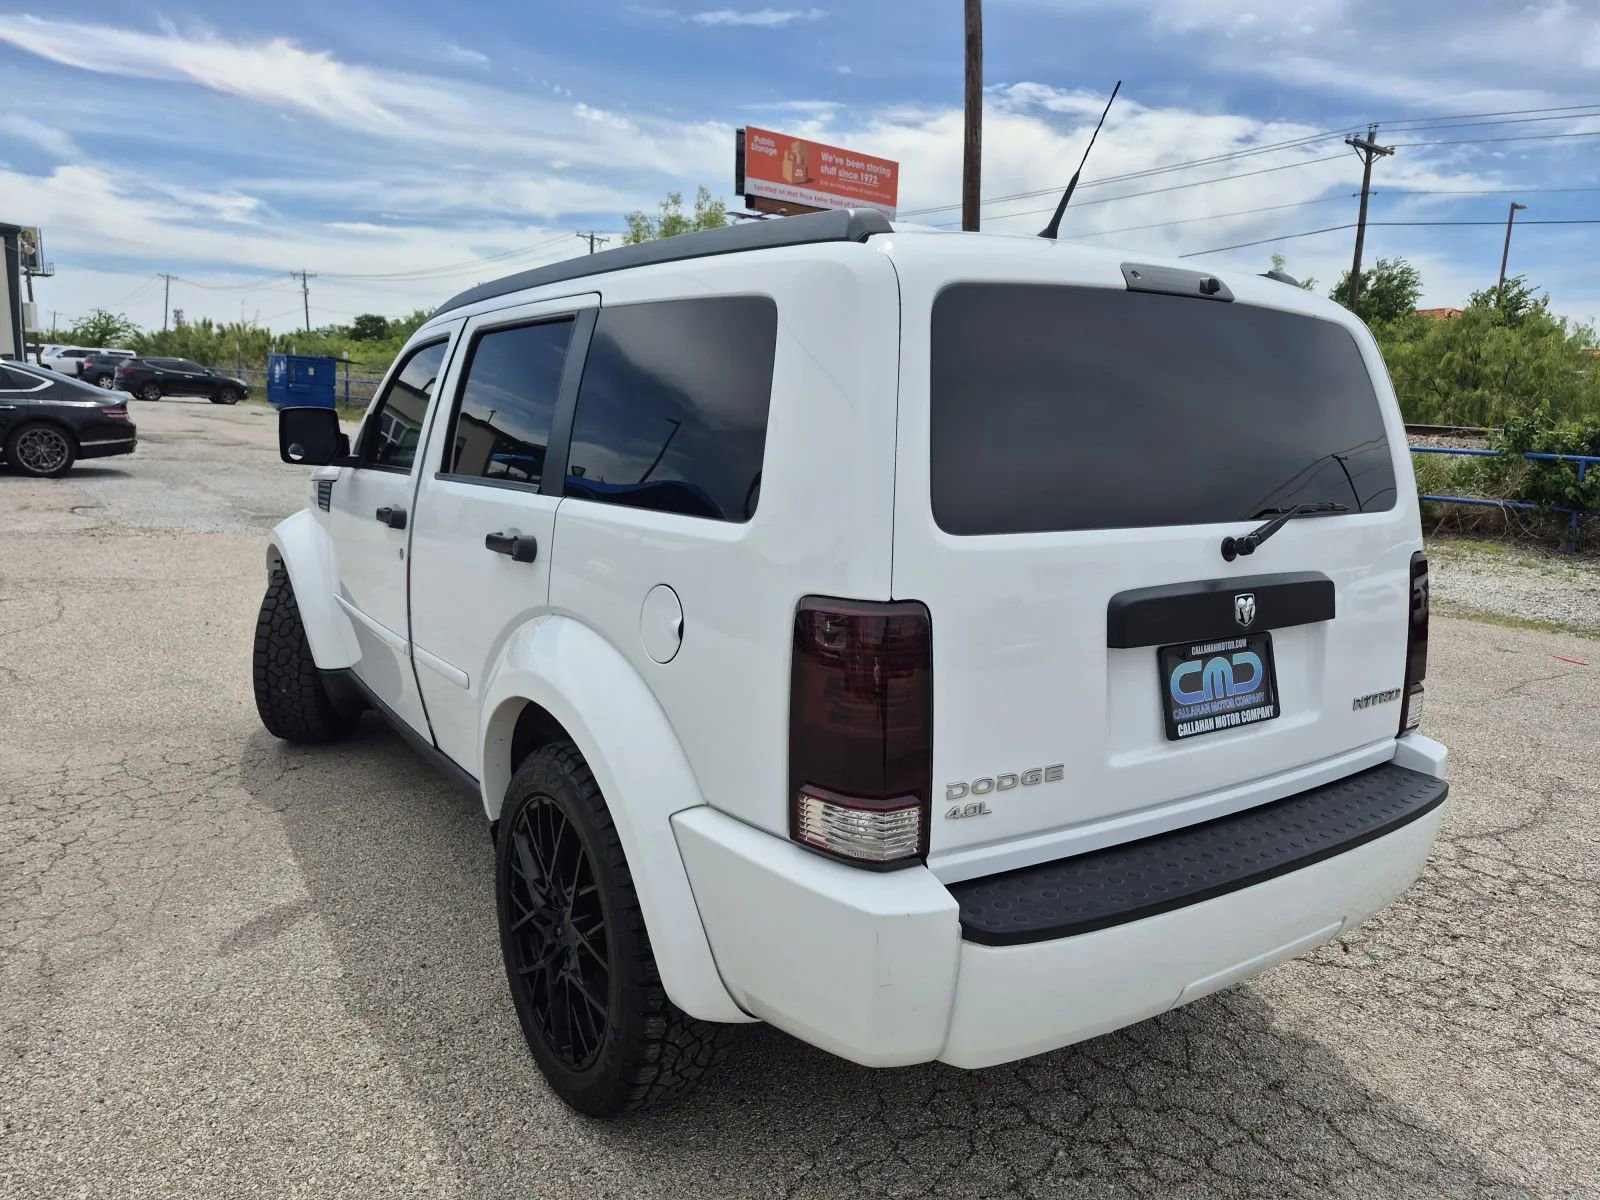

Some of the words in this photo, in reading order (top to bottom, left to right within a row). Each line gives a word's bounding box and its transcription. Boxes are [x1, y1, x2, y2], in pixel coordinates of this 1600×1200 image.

[751, 143, 778, 156] Storage
[753, 135, 776, 147] Public
[821, 152, 844, 165] We've
[846, 157, 865, 169] been
[866, 163, 891, 178] storing
[821, 165, 837, 177] stuff
[838, 169, 858, 180] since
[860, 172, 879, 185] 1972.
[1191, 638, 1247, 656] CALLAHANMOTOR.COM
[1173, 704, 1211, 720] CALLAHAN
[1211, 699, 1235, 713] MOTOR
[1235, 692, 1265, 706] COMPANY
[1353, 688, 1401, 712] NITRO
[1177, 718, 1215, 736] CALLAHAN
[1215, 713, 1241, 729] MOTOR
[1241, 705, 1274, 723] COMPANY
[946, 763, 1065, 801] DODGE
[945, 801, 992, 820] 4.0L
